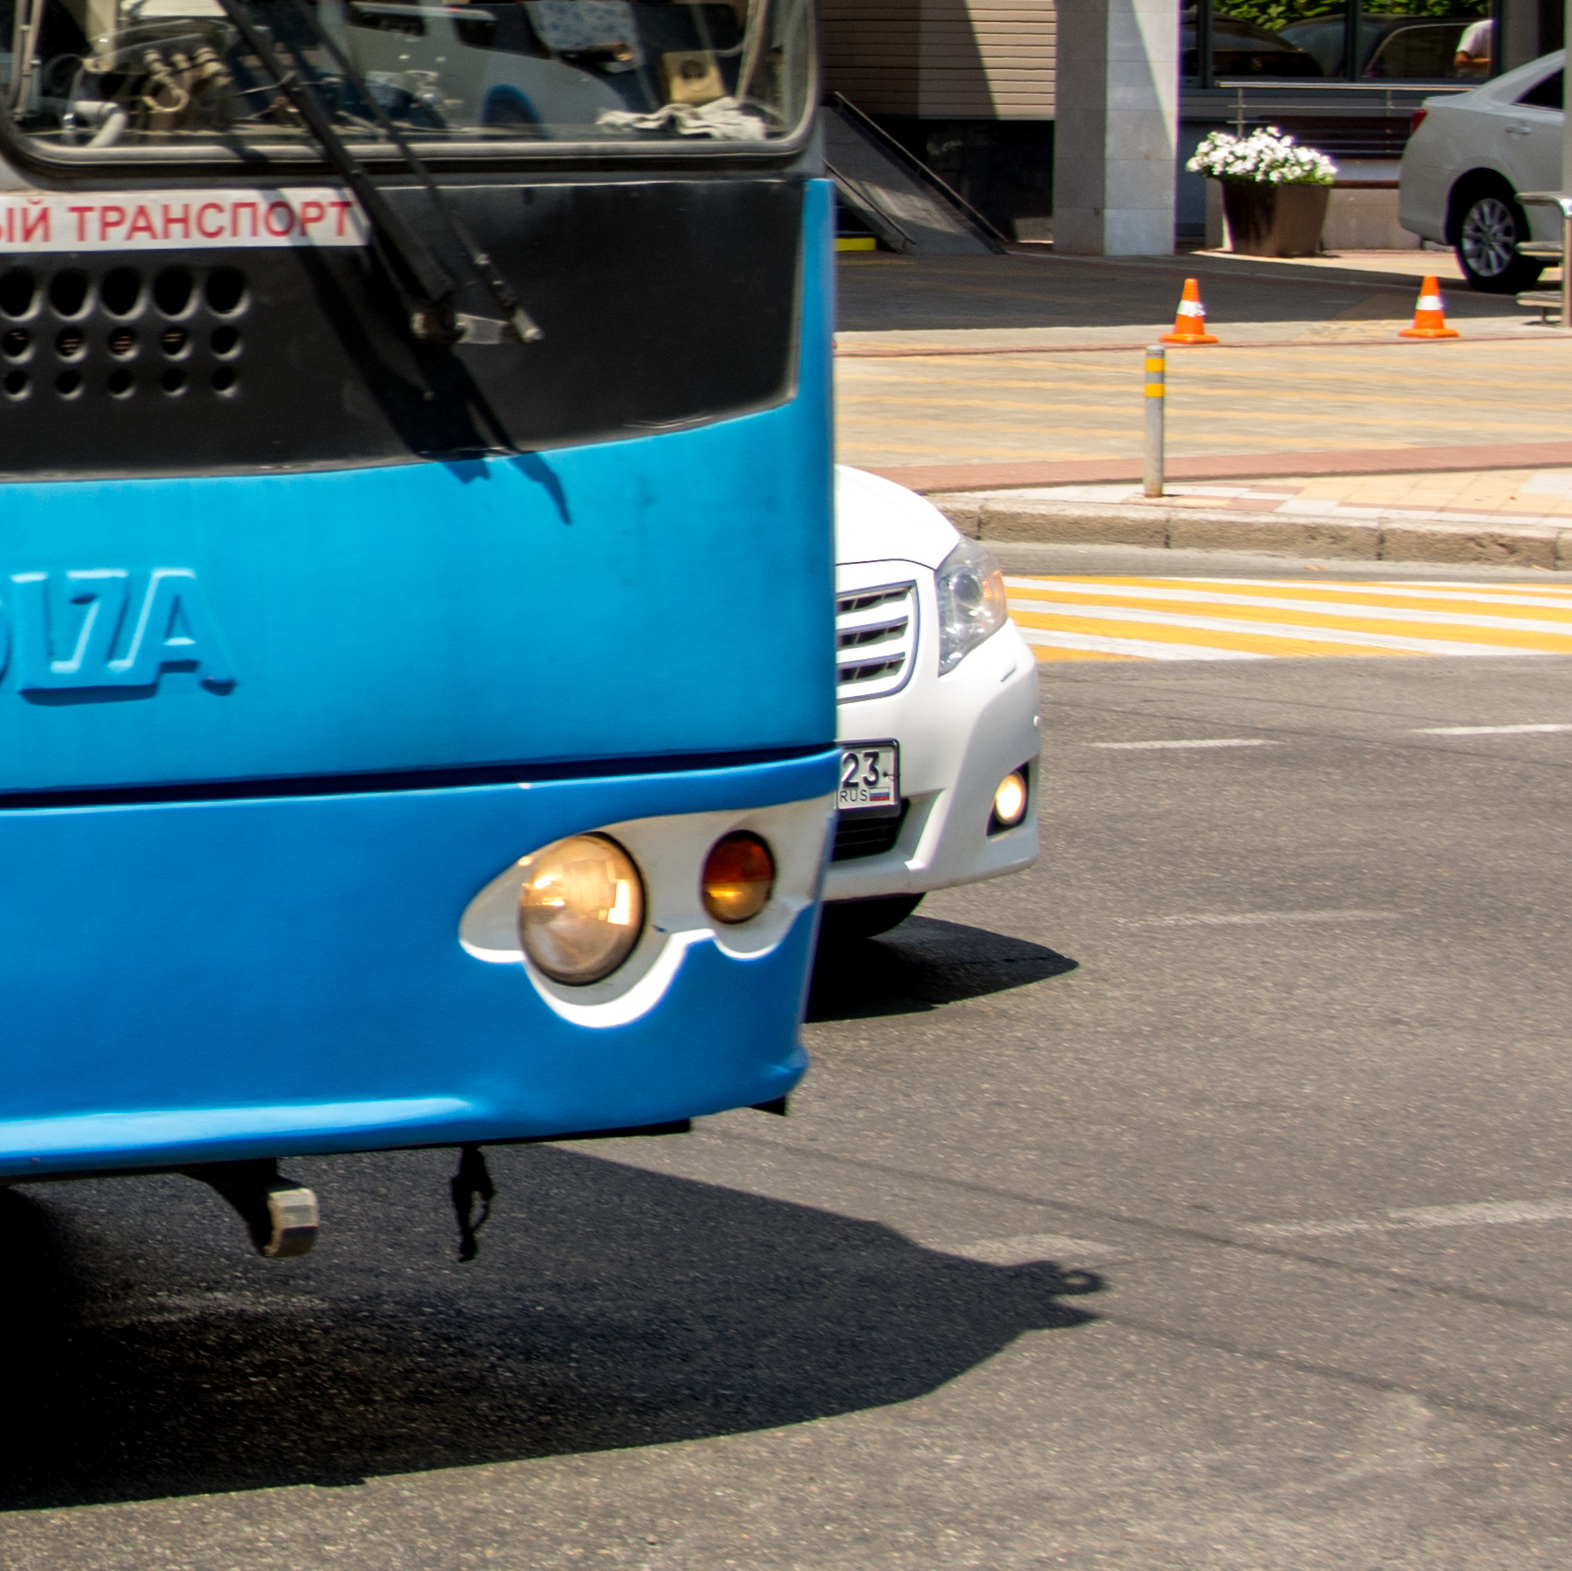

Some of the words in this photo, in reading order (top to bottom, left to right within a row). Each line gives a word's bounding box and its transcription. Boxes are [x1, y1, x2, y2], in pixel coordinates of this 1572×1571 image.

[66, 199, 354, 244] ТРАНСПОРТ
[841, 751, 880, 789] 23
[839, 788, 868, 803] RUS
